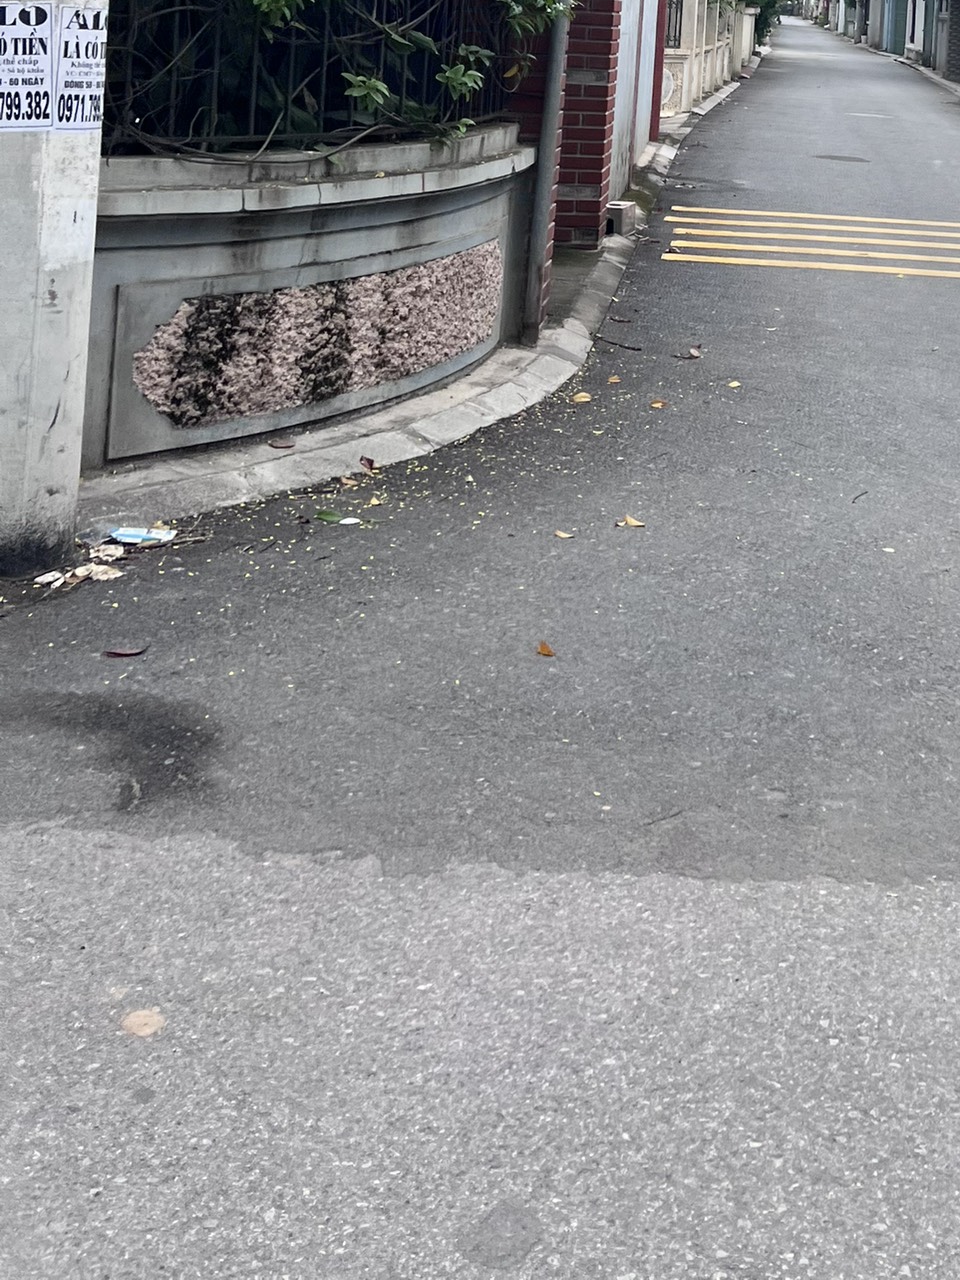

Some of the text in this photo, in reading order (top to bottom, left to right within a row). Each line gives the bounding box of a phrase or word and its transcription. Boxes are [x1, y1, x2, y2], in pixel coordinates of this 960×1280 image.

[10, 28, 48, 55] TIỀN
[63, 35, 80, 58] LÀ
[85, 36, 98, 59] CÓ
[21, 76, 44, 86] NGÀY
